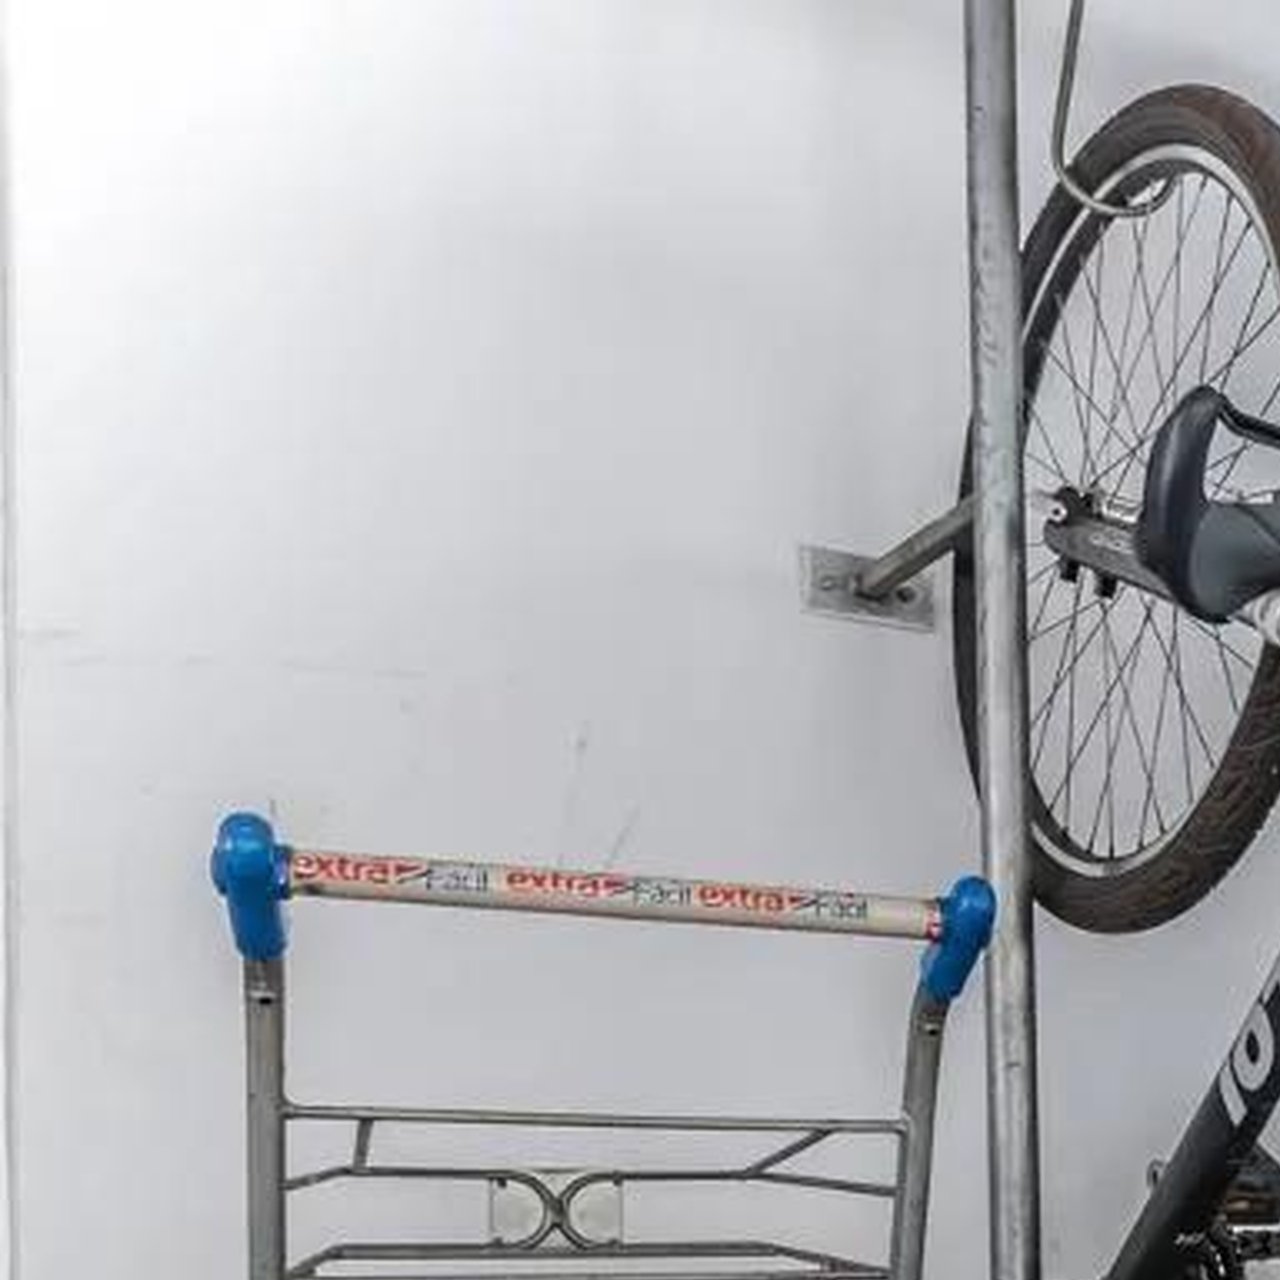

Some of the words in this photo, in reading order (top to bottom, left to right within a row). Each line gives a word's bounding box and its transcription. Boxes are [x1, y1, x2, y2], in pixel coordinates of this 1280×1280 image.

[293, 854, 390, 884] extra
[506, 870, 603, 898] extra
[698, 884, 785, 913] extra
